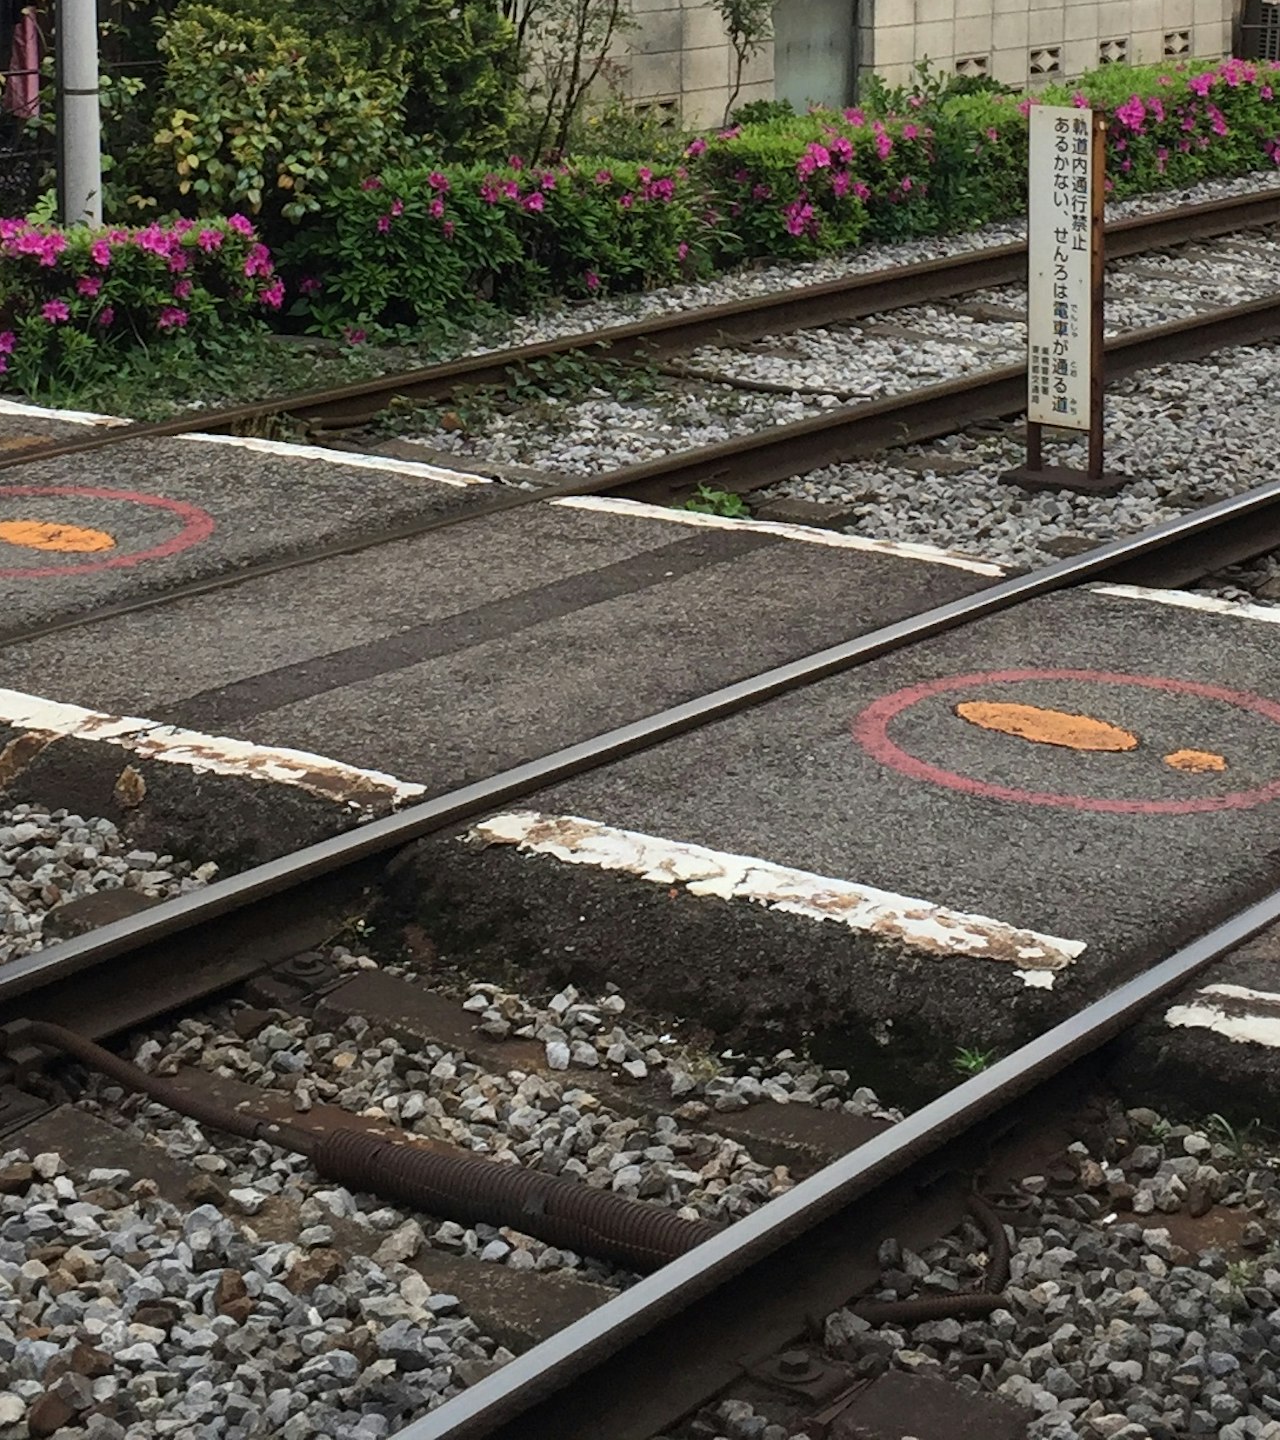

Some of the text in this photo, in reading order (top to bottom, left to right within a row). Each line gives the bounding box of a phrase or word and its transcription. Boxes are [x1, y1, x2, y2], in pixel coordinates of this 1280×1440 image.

[1052, 117, 1069, 413] あるかない、せんろは電車が通る道
[1071, 118, 1088, 251] 軌道内通行禁止
